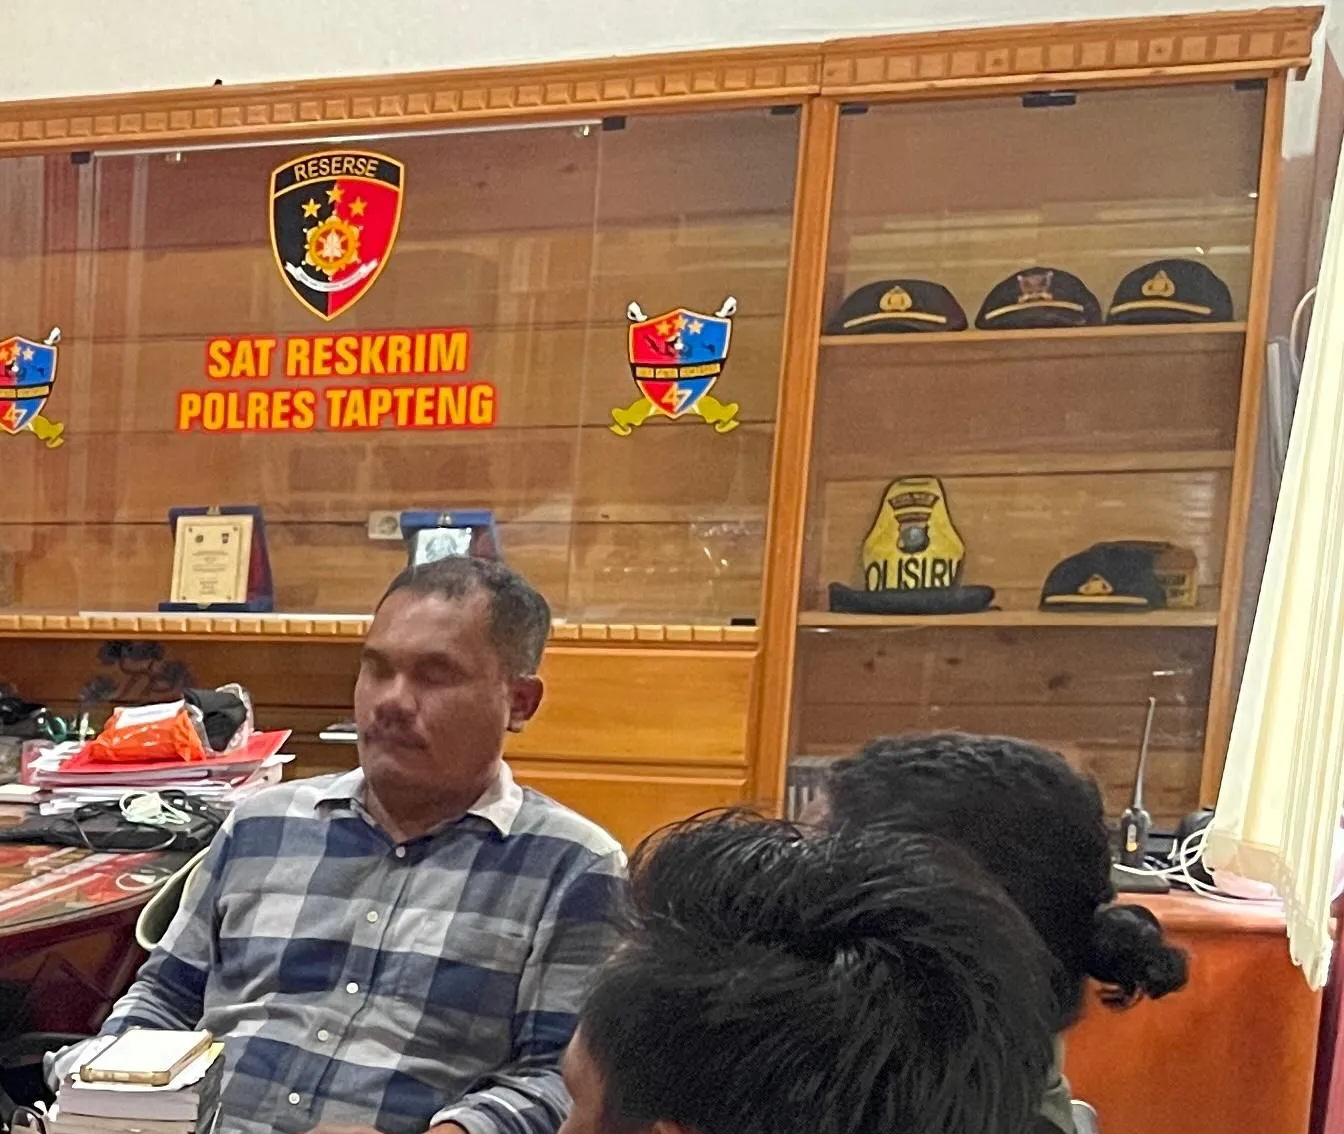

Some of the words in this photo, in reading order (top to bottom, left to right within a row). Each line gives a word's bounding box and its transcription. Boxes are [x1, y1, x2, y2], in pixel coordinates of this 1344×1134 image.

[293, 156, 379, 182] RESERSE
[208, 339, 276, 378] SAT
[286, 332, 468, 376] RESKRIM
[178, 390, 315, 430] POLRES
[325, 384, 495, 428] TAPTENG
